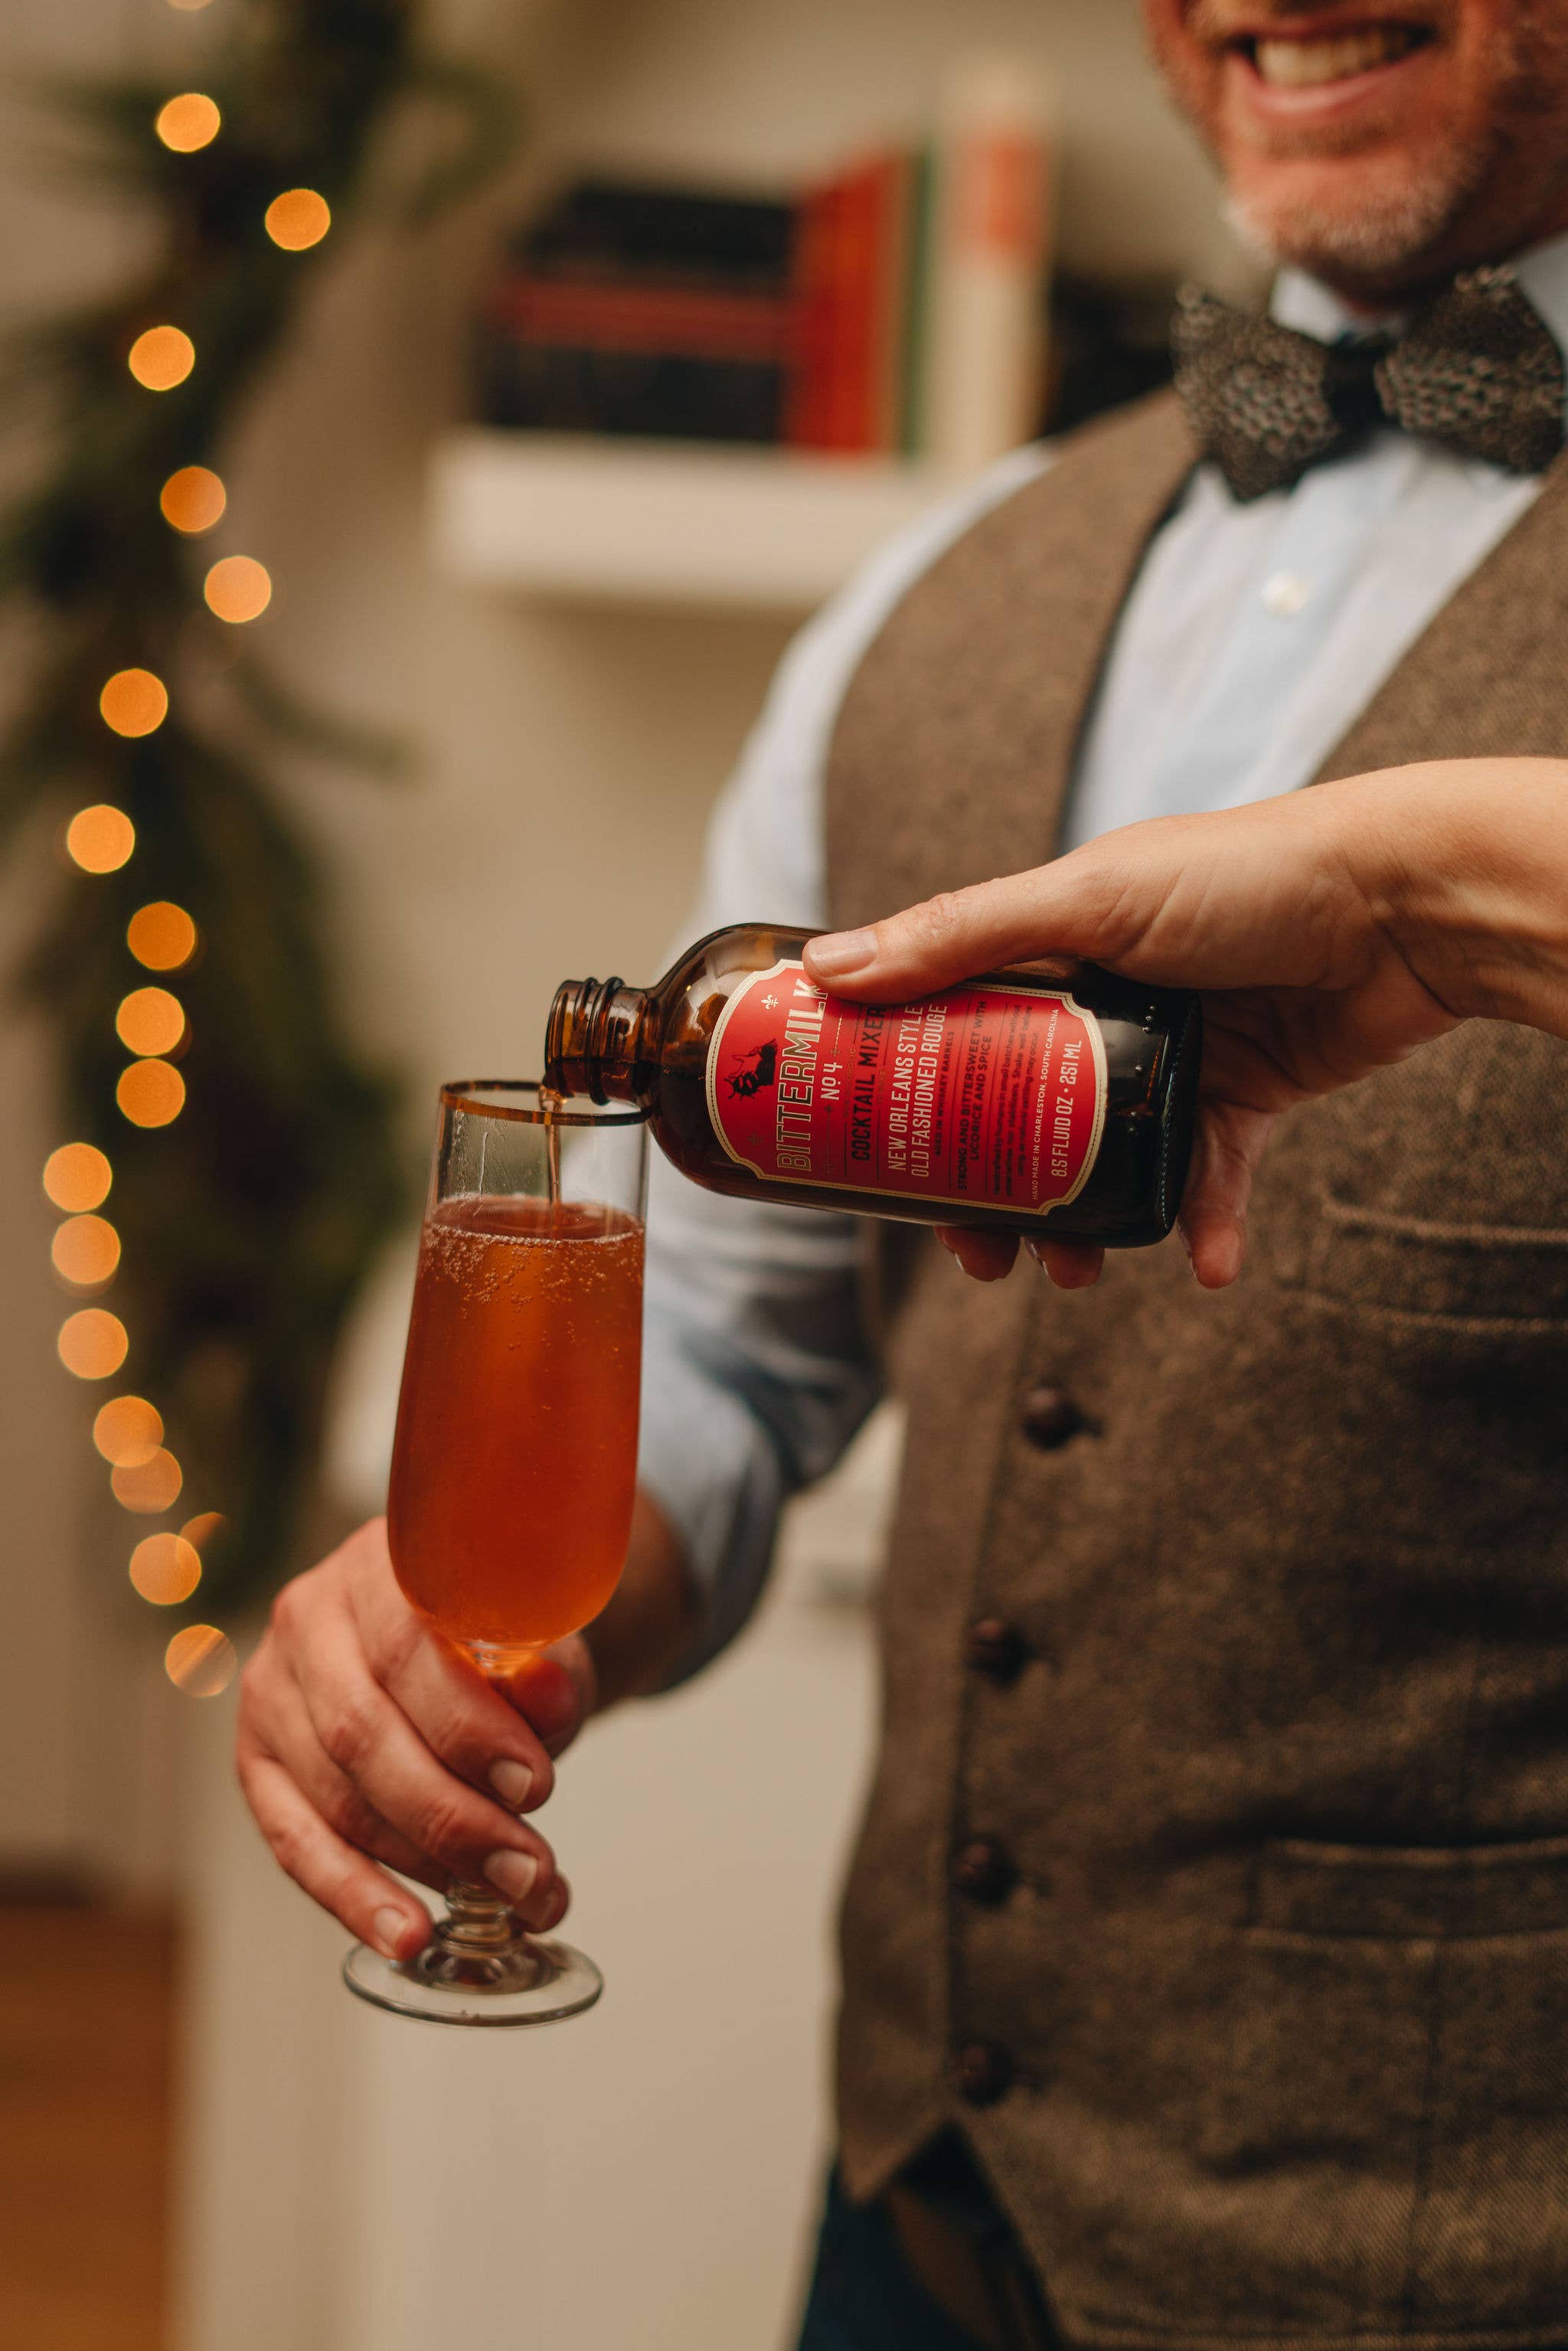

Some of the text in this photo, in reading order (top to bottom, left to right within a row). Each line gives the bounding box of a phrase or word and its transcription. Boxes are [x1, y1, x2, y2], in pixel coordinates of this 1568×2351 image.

[1045, 1008, 1059, 1049] CAROLINA
[1063, 1038, 1081, 1059] ML
[942, 1030, 953, 1072] BARRELS
[1002, 1033, 1013, 1067] batches
[1012, 1052, 1022, 1079] Shake
[1040, 1050, 1050, 1080] SOUTH
[776, 978, 828, 1171] BITTERMILK
[851, 1004, 885, 1161] COCKTAIL MIXER
[888, 1004, 923, 1171] NEW ORLEANS STYLE
[911, 1004, 946, 1177] OLD FASHIONED ROUGE
[937, 1074, 947, 1117] WHISKEY
[958, 1000, 986, 1190] STRONG AND BITTERSWEET WITH
[970, 1035, 991, 1161] LICORICE AND SPICE
[1034, 1082, 1046, 1143] CHARLESTON,
[1056, 1096, 1073, 1115] OZ
[936, 1119, 942, 1129] IN
[1053, 1115, 1070, 1157] FLUID
[1033, 1144, 1039, 1154] IN
[1051, 1158, 1067, 1177] 8.5
